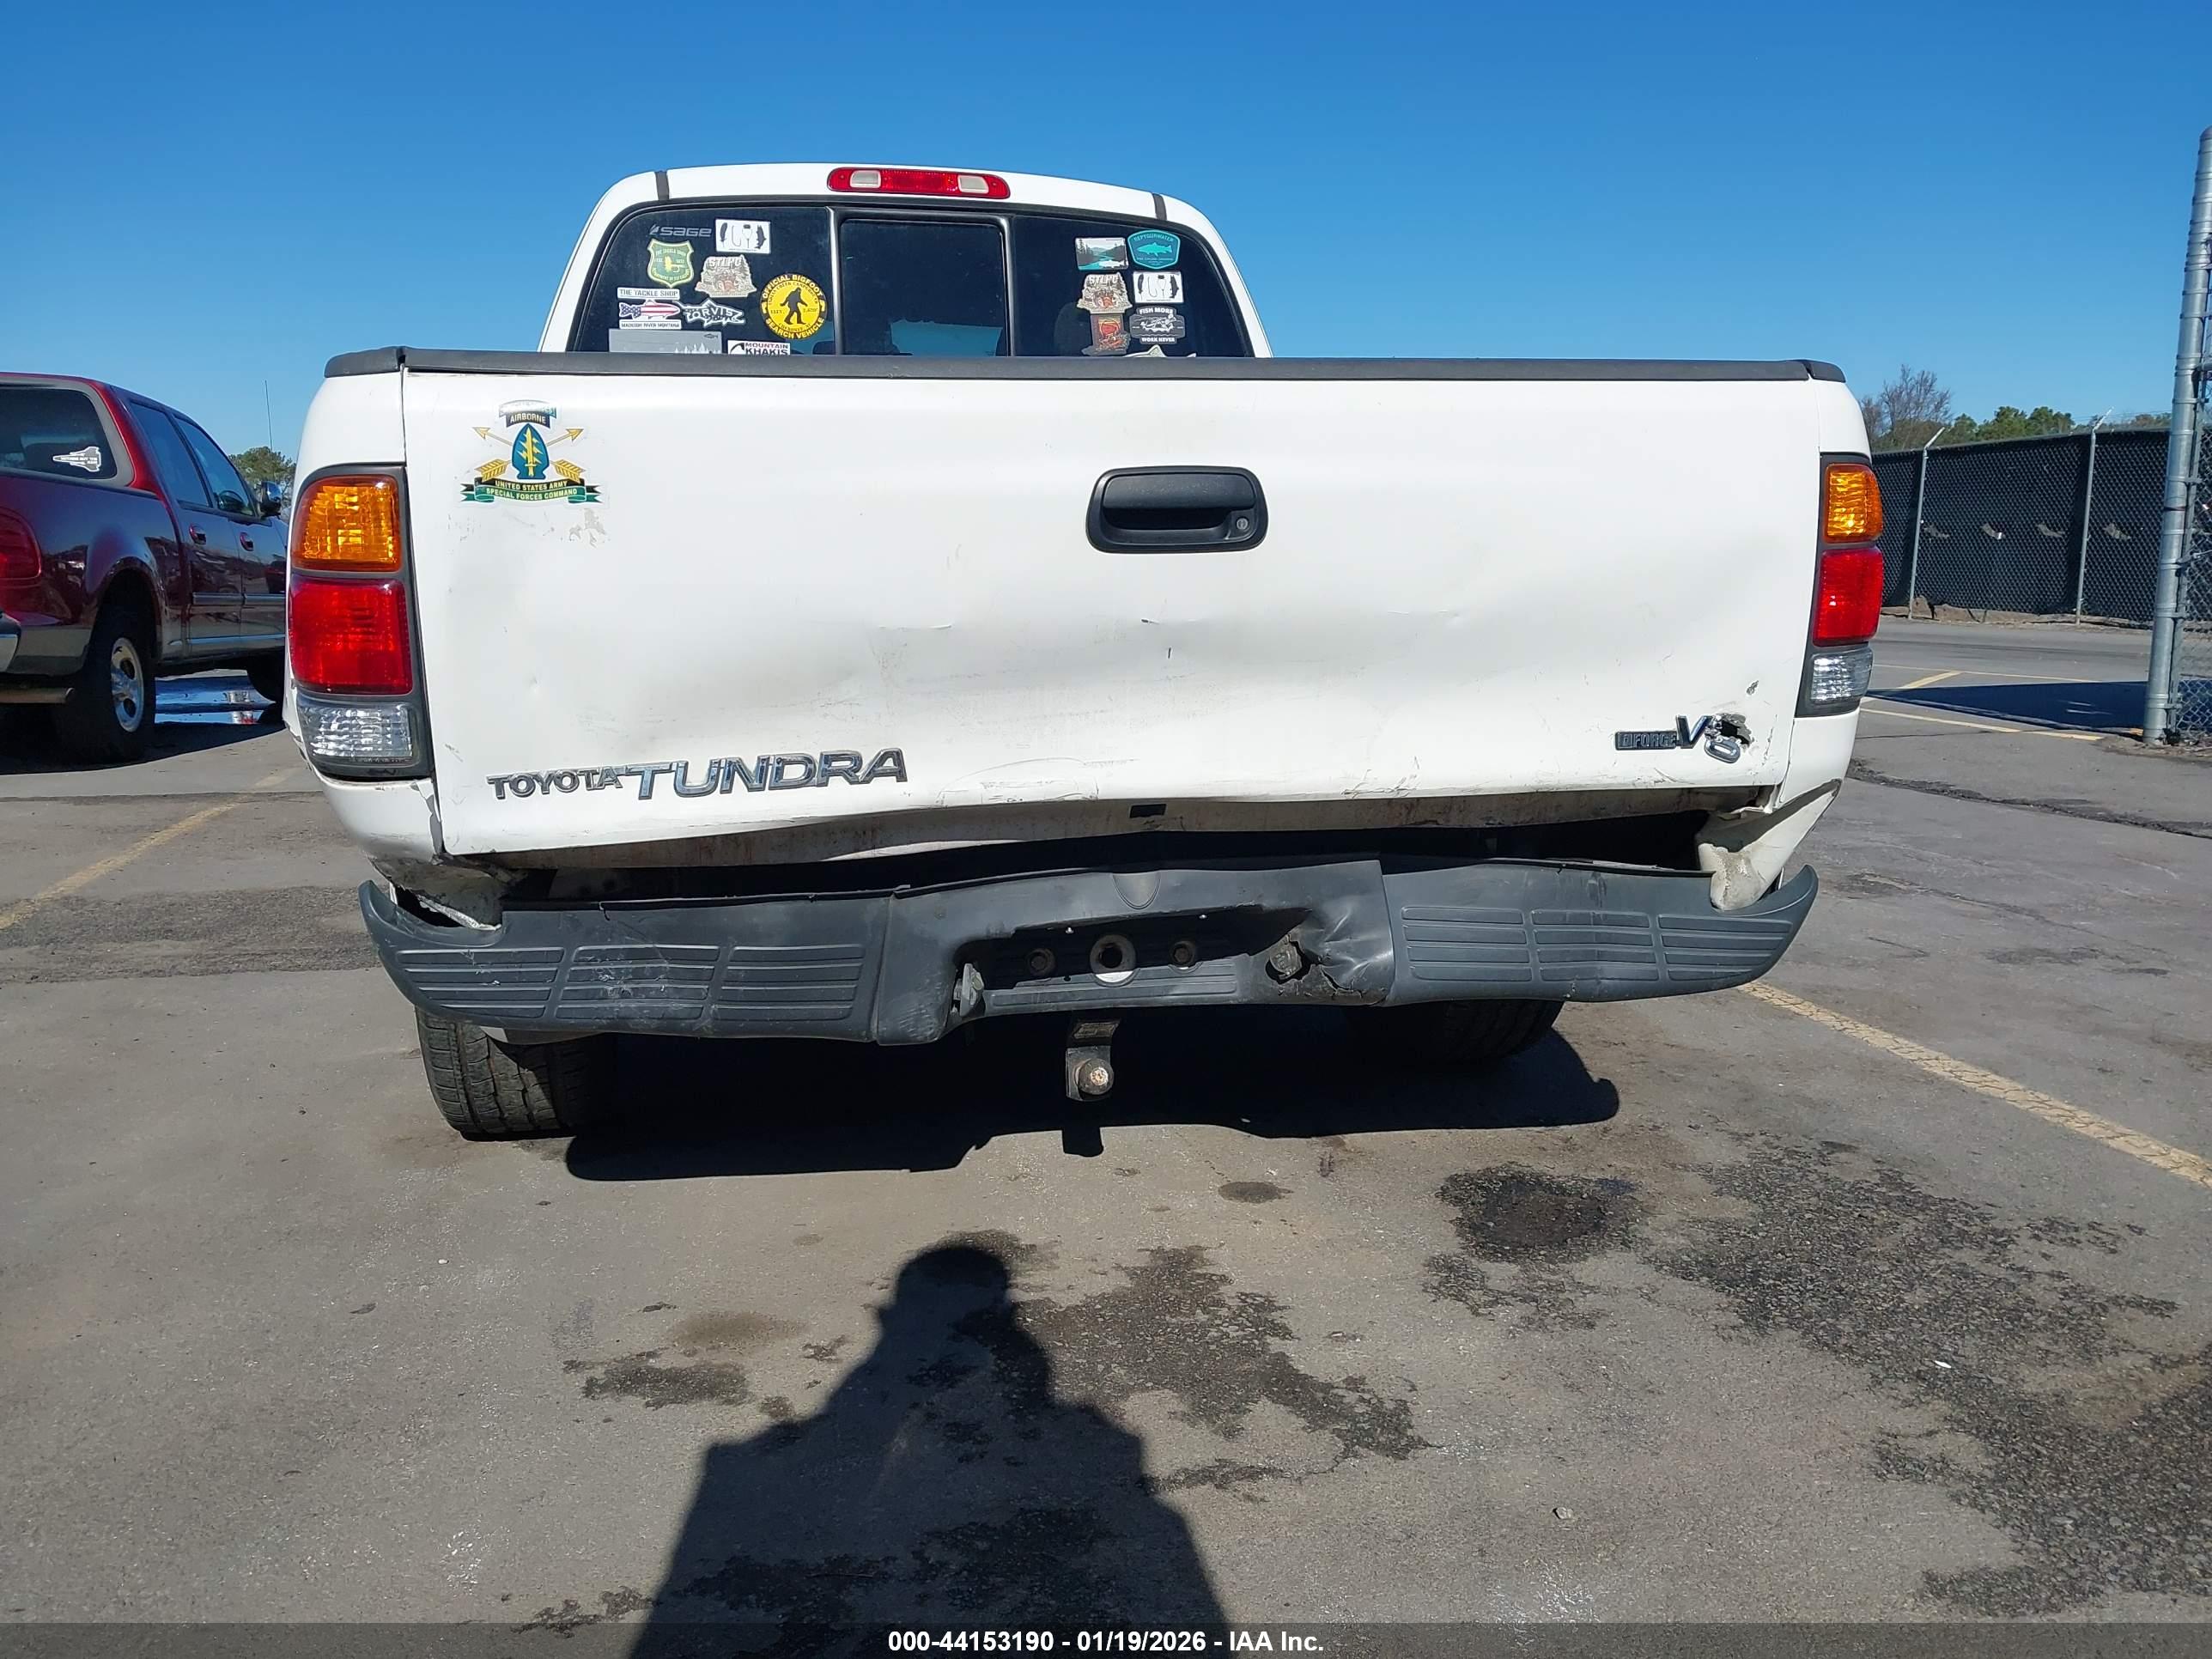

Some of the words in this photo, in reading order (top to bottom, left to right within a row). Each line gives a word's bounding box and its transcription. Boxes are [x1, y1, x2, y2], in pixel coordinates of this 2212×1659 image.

[762, 274, 791, 299] OFFICIAL
[792, 274, 823, 296] BIGFOOT
[692, 307, 732, 319] ORVIS
[765, 318, 794, 339] SEARCH
[795, 317, 824, 339] VEHICLE
[510, 412, 547, 424] AIRBORNE
[495, 480, 521, 490] UNITED
[549, 480, 568, 489] ARMY
[486, 487, 515, 499] SPECIAL
[515, 492, 543, 501] FORCES
[544, 488, 578, 499] COMMAND
[487, 766, 623, 800] TOYOTA
[625, 747, 908, 801] TUNDRA
